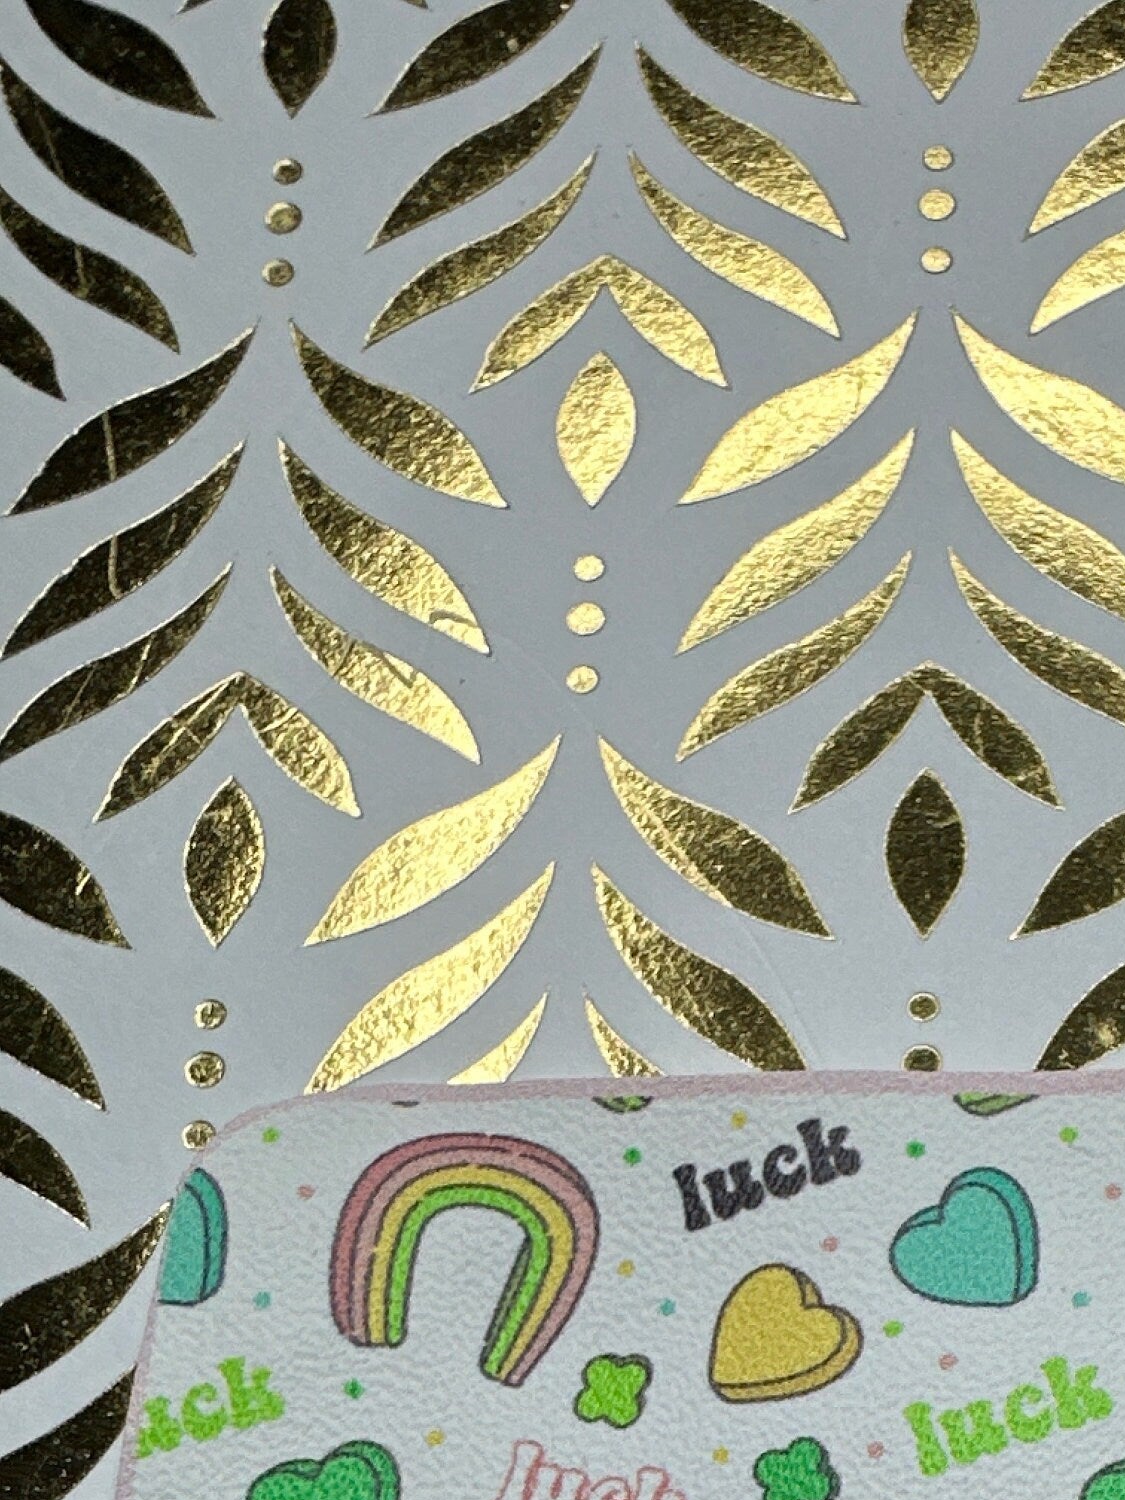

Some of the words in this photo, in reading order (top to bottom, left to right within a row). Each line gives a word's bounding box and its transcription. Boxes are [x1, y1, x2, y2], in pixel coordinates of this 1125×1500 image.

[672, 1117, 862, 1232] luck
[136, 1356, 286, 1458] uck
[903, 1355, 1114, 1476] luck
